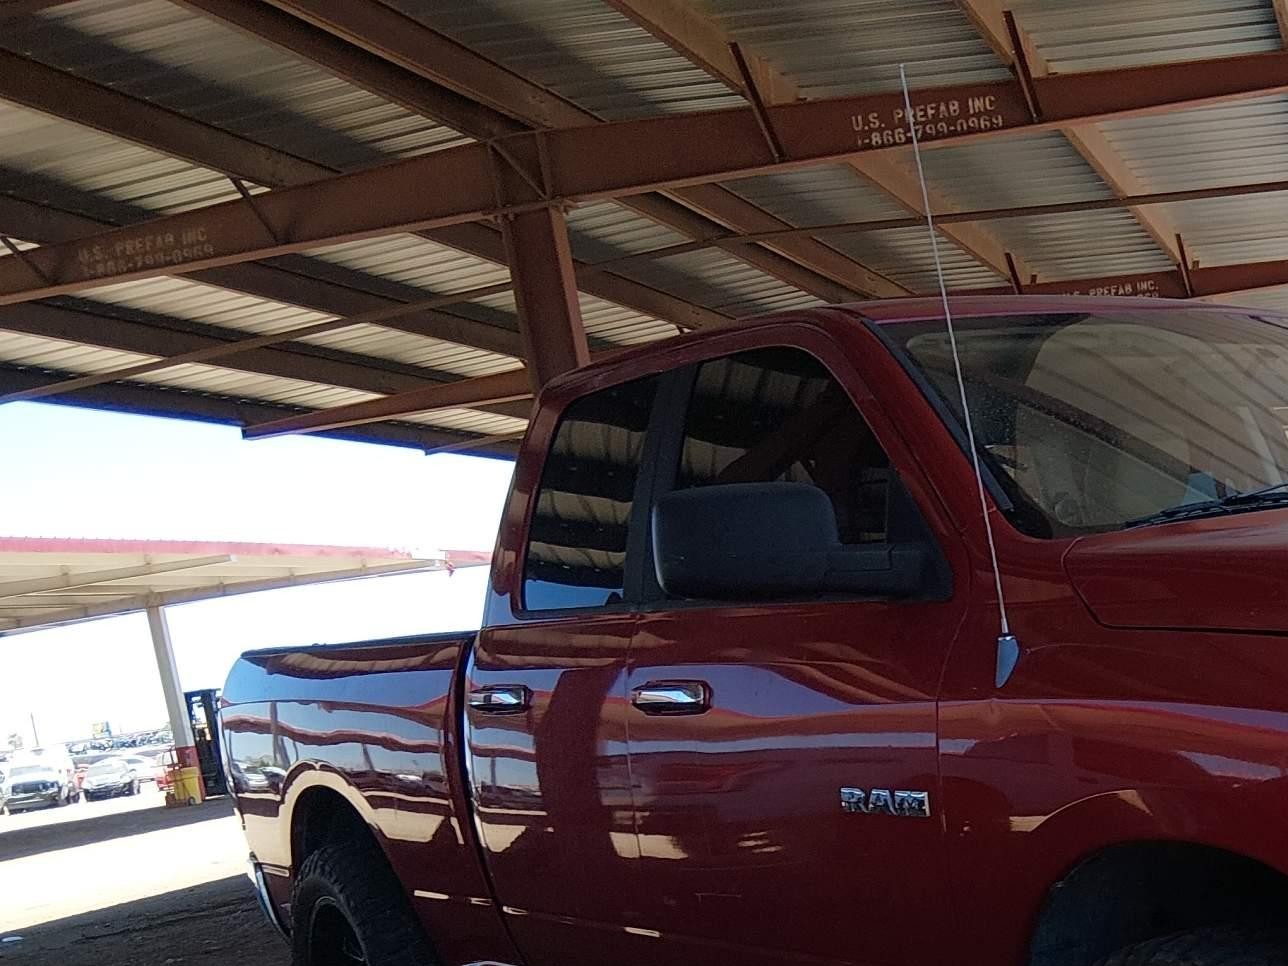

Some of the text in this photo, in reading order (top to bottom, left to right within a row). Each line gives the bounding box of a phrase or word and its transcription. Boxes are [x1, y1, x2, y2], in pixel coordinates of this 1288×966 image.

[851, 95, 996, 132] U.S. PREFAB INC
[840, 787, 931, 817] RAM
